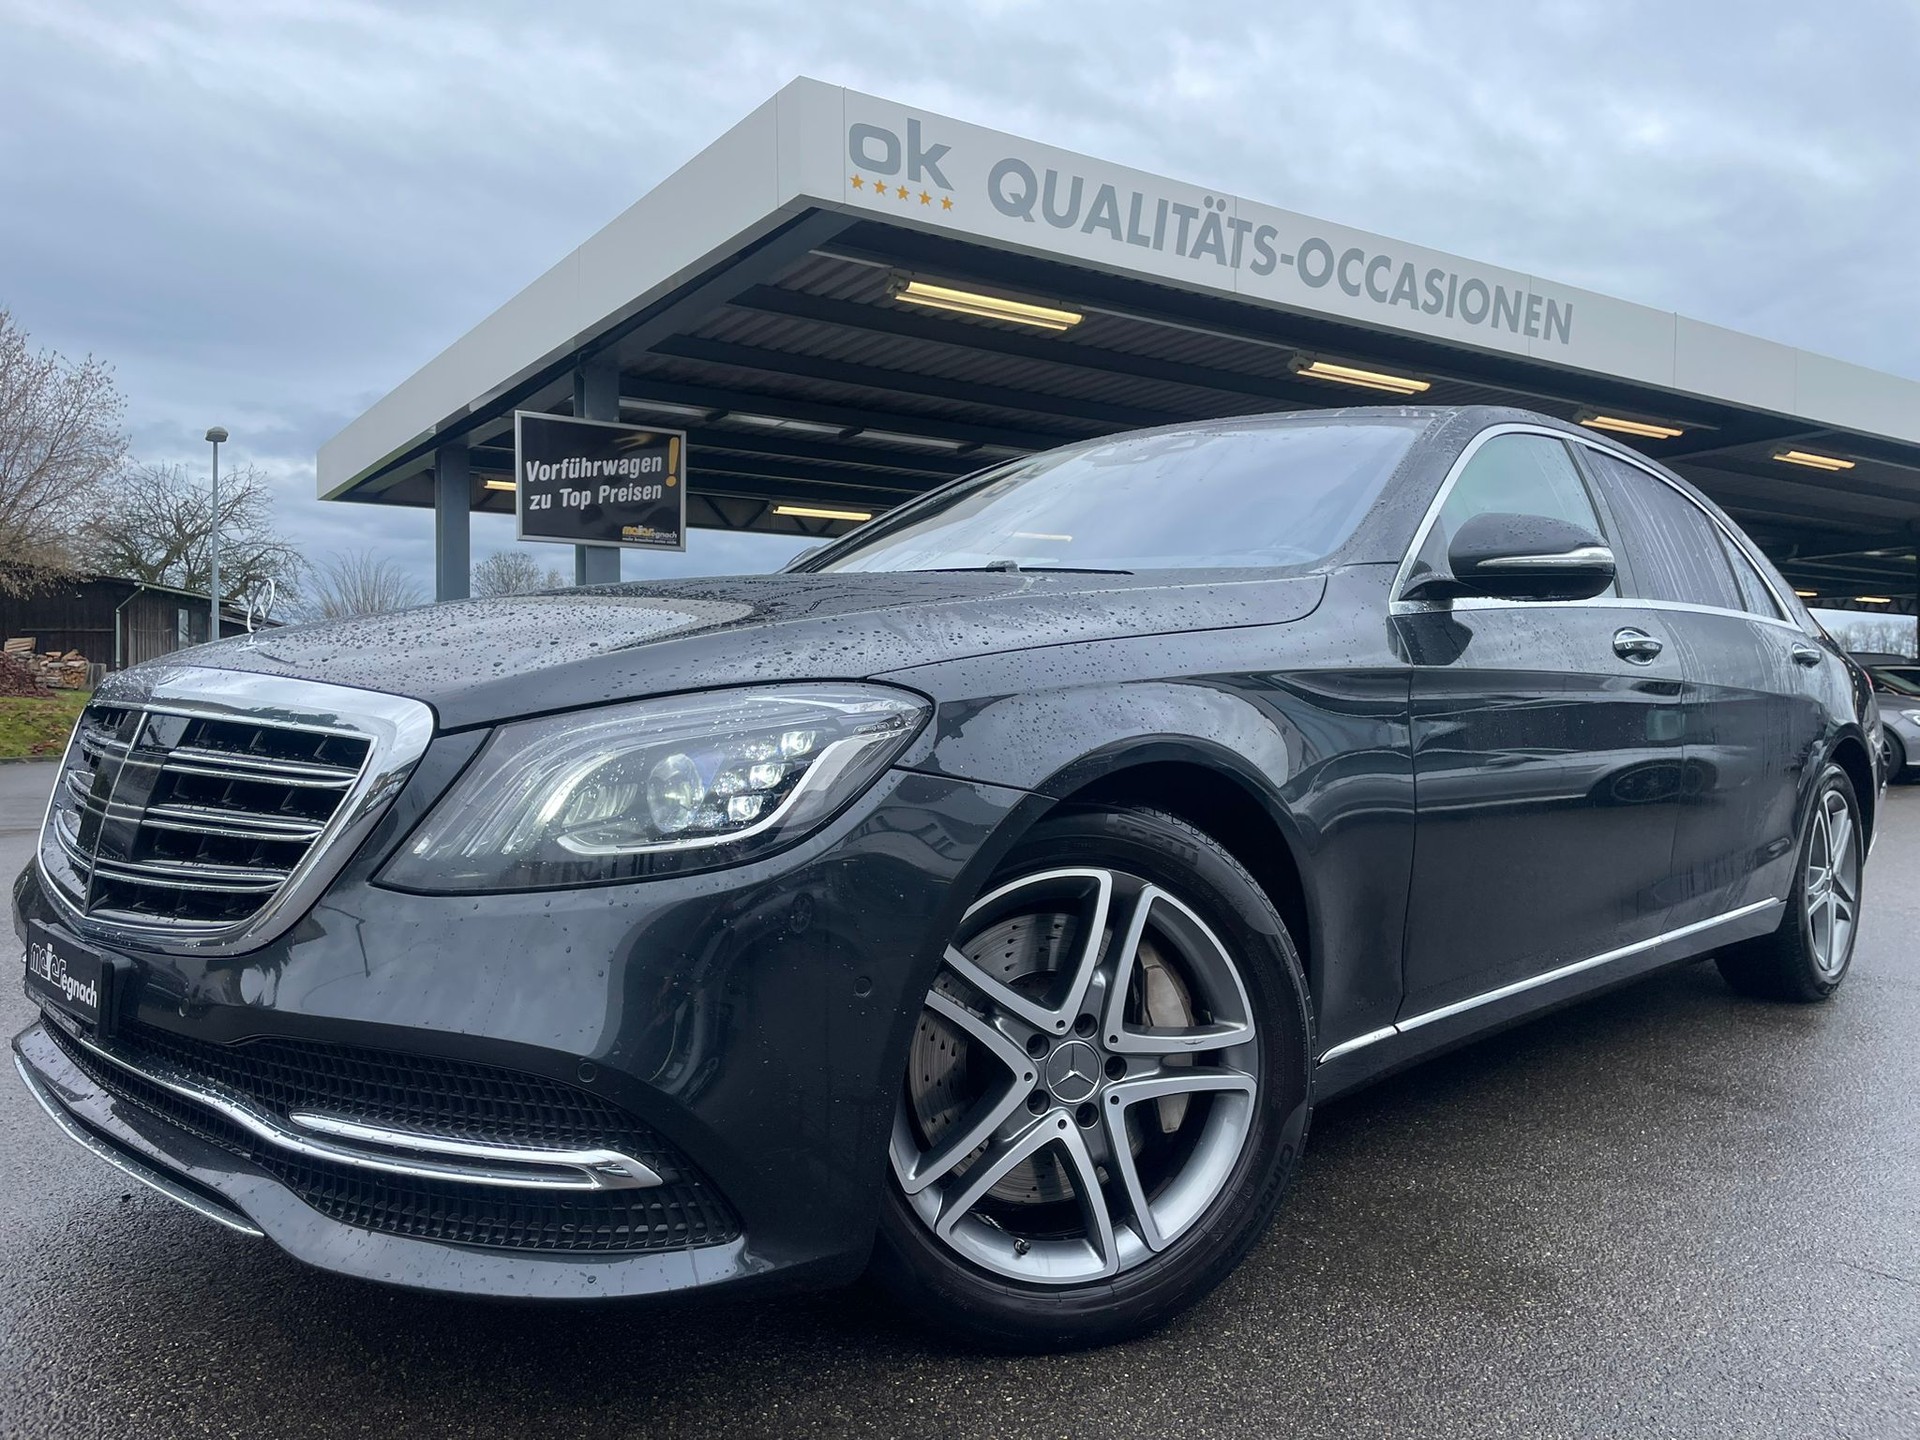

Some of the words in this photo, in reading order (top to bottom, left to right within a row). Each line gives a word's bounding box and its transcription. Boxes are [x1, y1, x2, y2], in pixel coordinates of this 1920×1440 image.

[849, 118, 954, 191] ok
[988, 158, 1573, 344] QUALITÄTS-OCCASIONEN
[526, 456, 662, 482] Vorführwagen
[529, 493, 552, 510] zu
[559, 488, 591, 510] Top
[598, 483, 662, 504] Preisen
